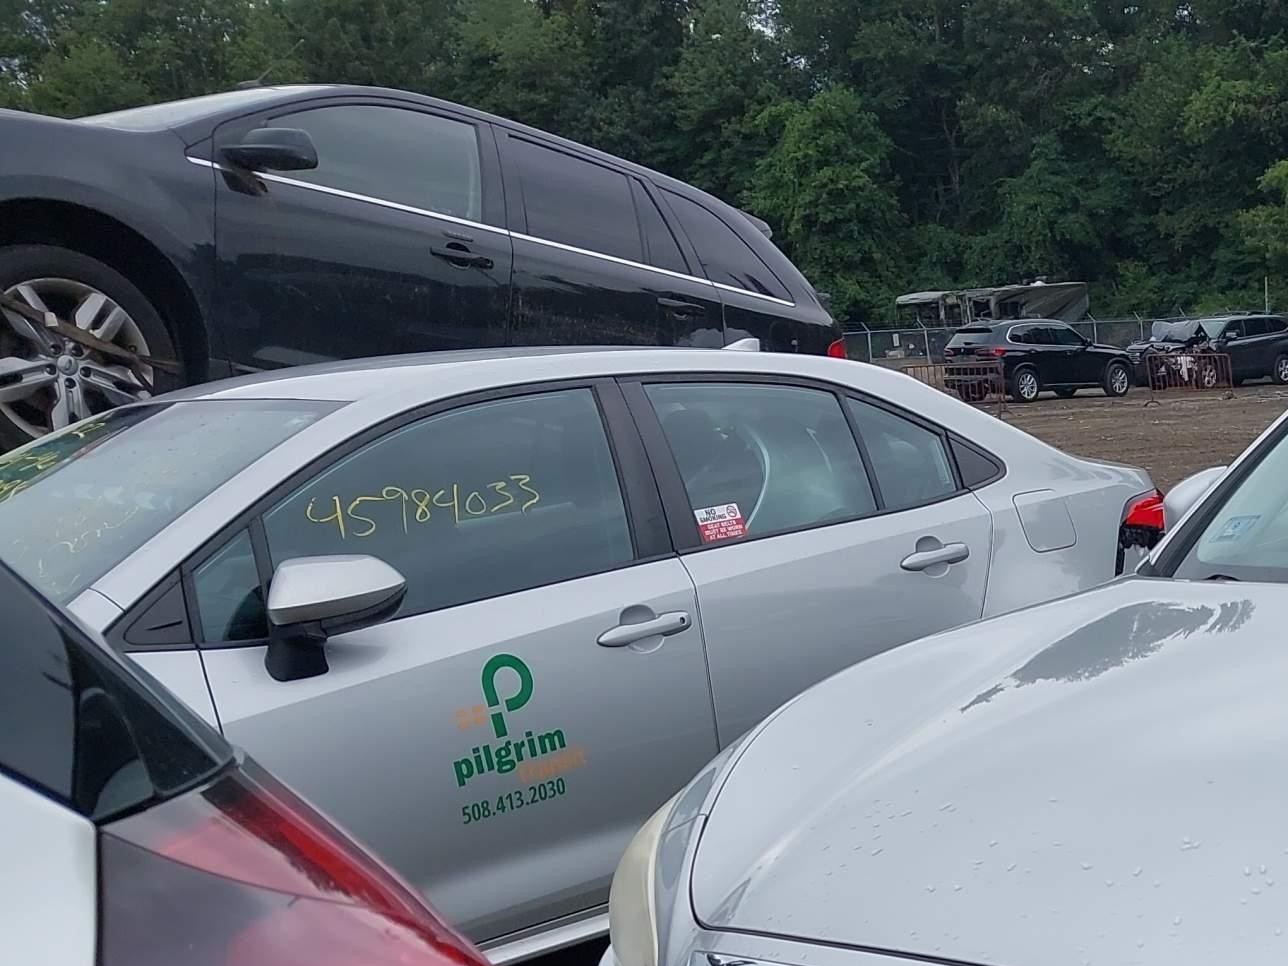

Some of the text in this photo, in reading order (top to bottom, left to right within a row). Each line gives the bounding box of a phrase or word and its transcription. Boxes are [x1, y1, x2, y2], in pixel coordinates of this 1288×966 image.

[306, 474, 540, 539] 45984033
[704, 508, 717, 516] NO
[453, 729, 567, 788] pilgrim
[461, 777, 567, 825] 508.413.2030
